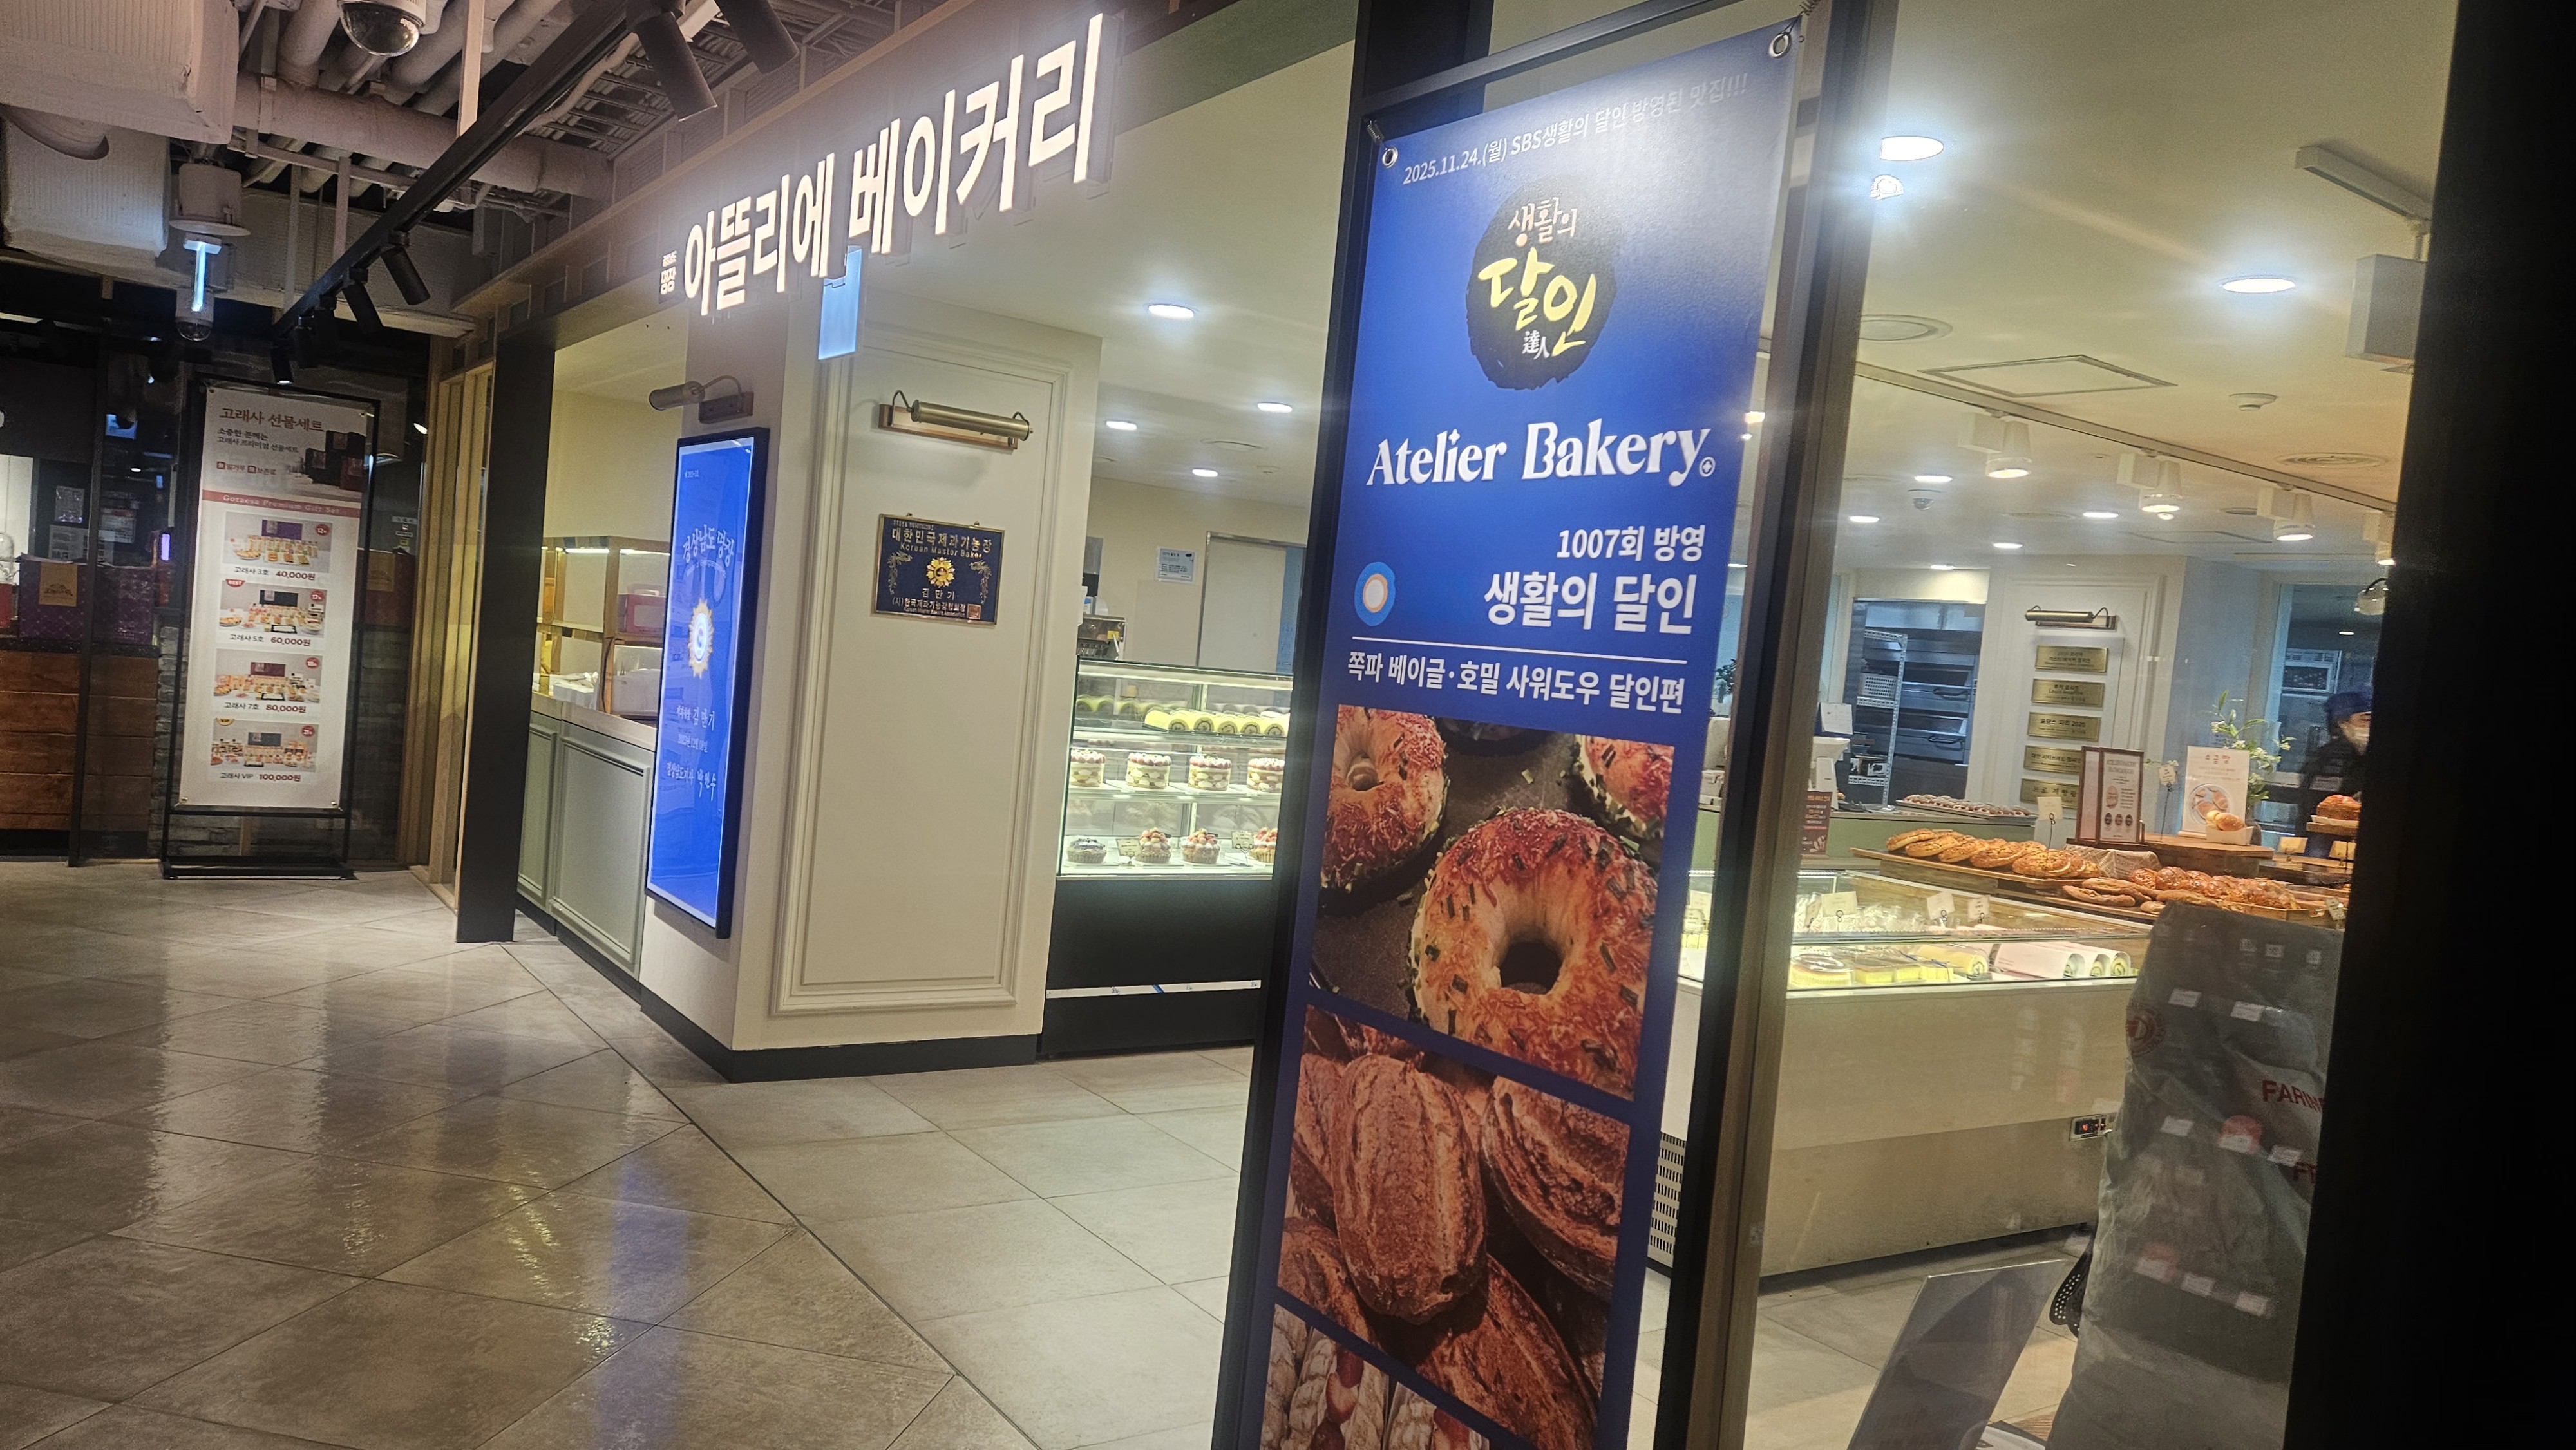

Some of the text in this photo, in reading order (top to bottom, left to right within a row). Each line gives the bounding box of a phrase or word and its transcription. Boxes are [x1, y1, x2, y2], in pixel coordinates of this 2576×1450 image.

[1403, 73, 1748, 185] 2025.11.24.(월) SBS생활의 달인 방영된 맛집!!!
[684, 13, 1103, 316] 아뜰리에 베이커리
[1508, 197, 1577, 247] 생활의
[660, 266, 676, 295] 명장
[1478, 247, 1596, 357] 달인
[1522, 330, 1549, 359] 達人
[218, 427, 243, 438] 소중한
[220, 408, 324, 433] 고래사 선물세트
[217, 437, 299, 453] 고래사 프리미엄 선물세트
[1366, 417, 1712, 487] Atelier Bakery
[263, 500, 301, 511] Premium
[305, 505, 323, 513] Gift
[326, 506, 341, 514] Set
[683, 523, 735, 567] 경상남도 명장
[900, 542, 983, 559] Korean Master Baker
[1556, 525, 1706, 562] 1007회 방영
[234, 566, 256, 575] 고래사
[276, 570, 316, 581] 40,000원
[1484, 571, 1697, 634] 생활의 달인
[230, 634, 251, 642] 고래사
[270, 637, 311, 647] 60,000원
[1348, 650, 1383, 683] 쪽파
[1506, 665, 1600, 705] 사워도우
[1610, 673, 1685, 714] 달인편
[265, 704, 306, 713] 80,000원
[258, 773, 301, 782] 100,000원
